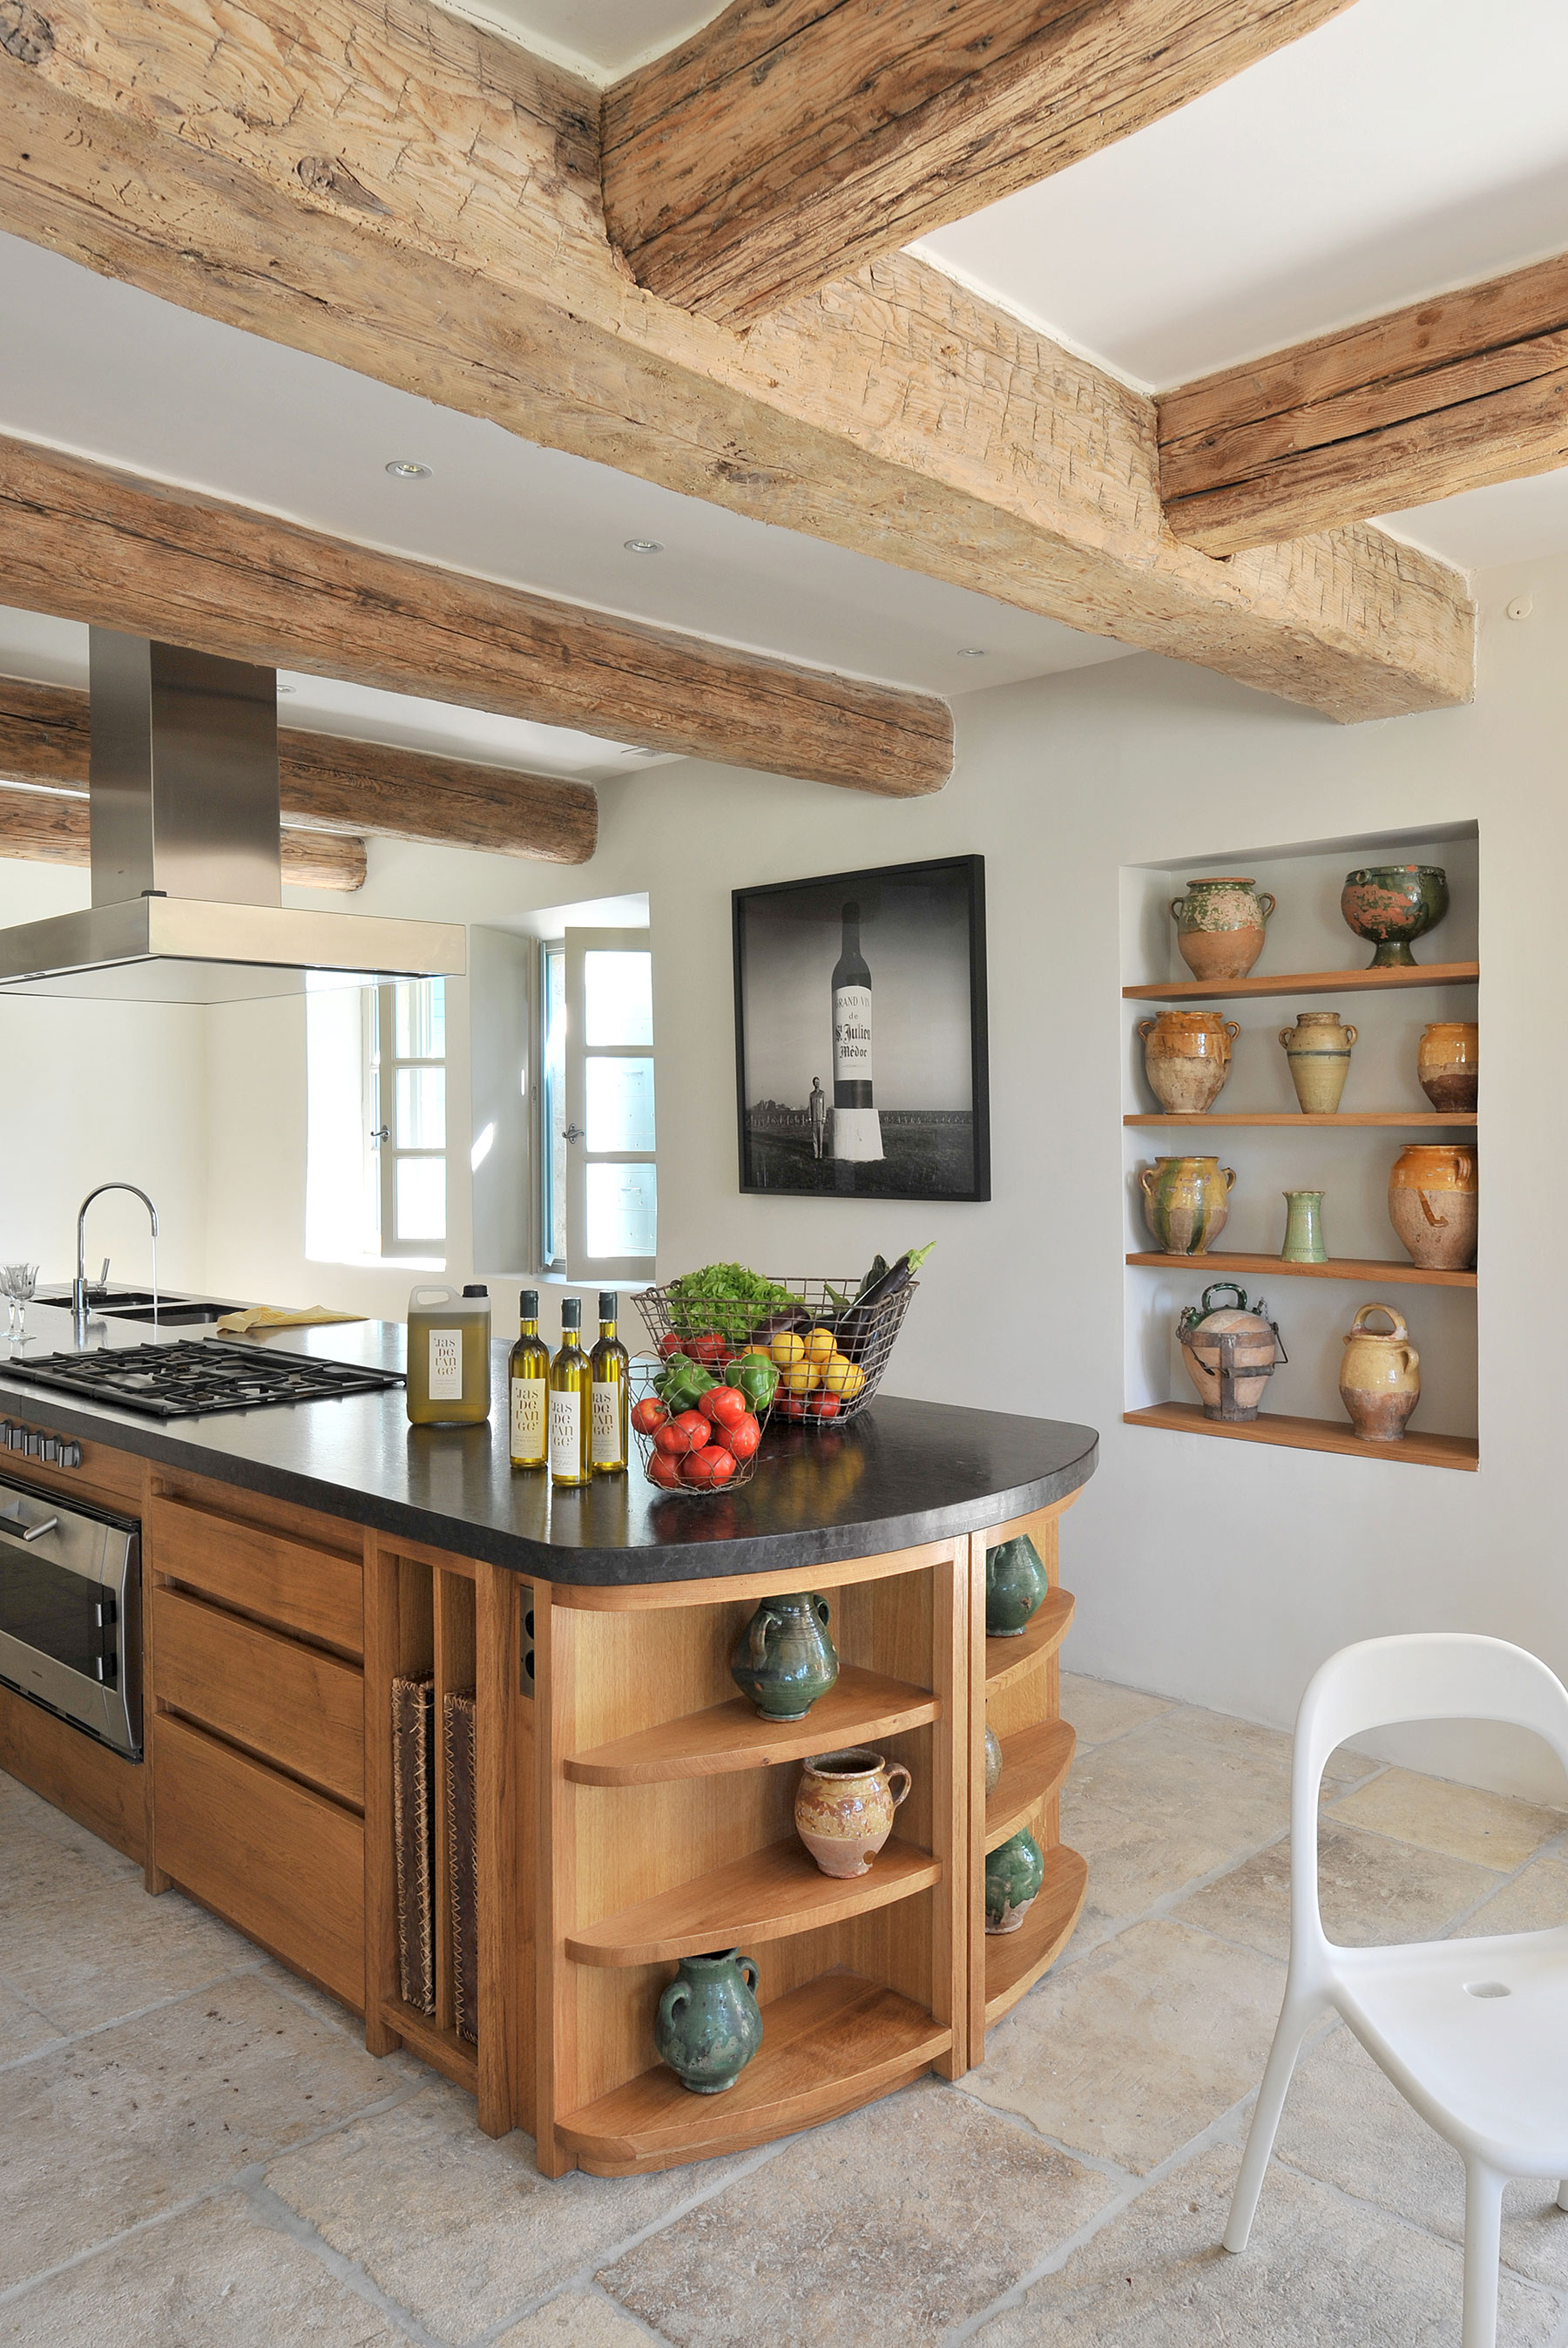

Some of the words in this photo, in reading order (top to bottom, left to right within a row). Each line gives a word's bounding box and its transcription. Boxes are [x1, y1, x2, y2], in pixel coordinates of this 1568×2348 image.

[848, 1012, 858, 1020] de
[843, 1023, 871, 1045] Julien
[840, 1045, 868, 1059] Médoc
